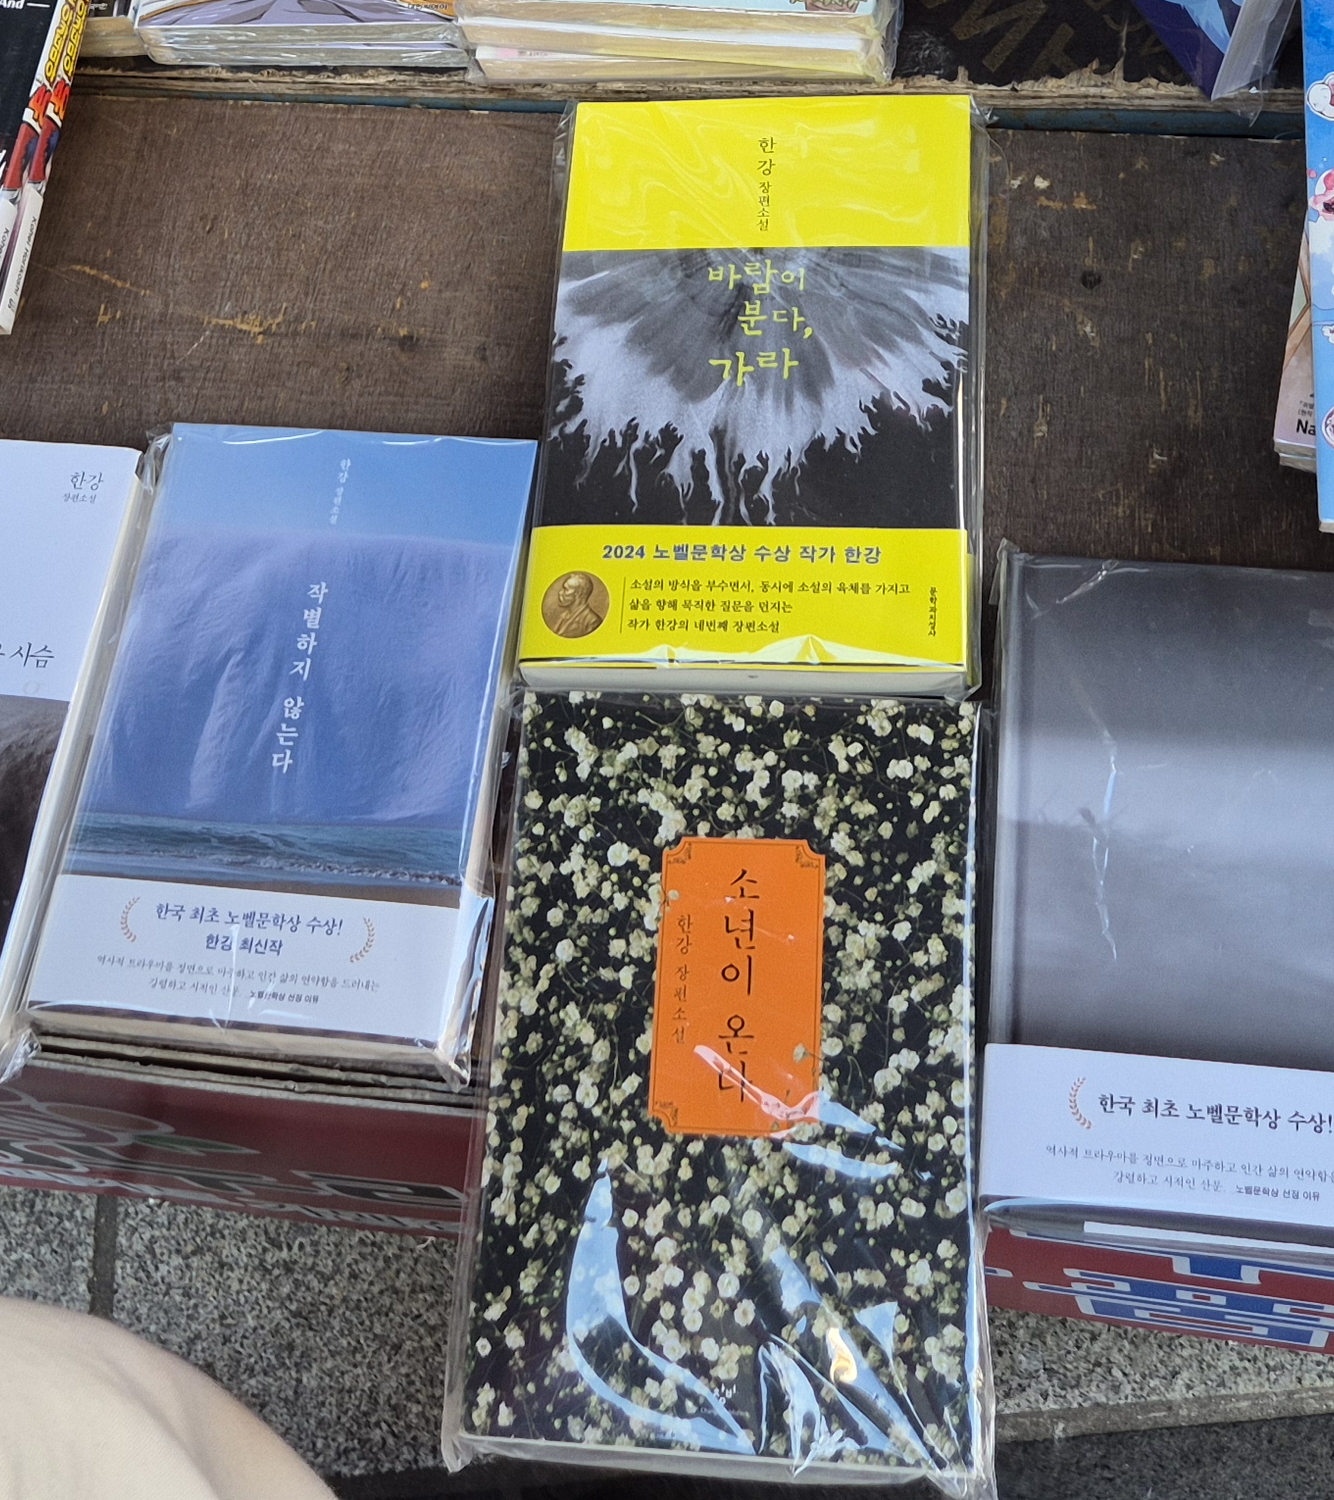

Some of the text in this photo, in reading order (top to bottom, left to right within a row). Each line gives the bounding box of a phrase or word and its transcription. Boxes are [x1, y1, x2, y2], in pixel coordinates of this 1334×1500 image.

[757, 136, 776, 175] 한강
[708, 258, 806, 295] 바람이
[739, 301, 812, 339] 분다,
[708, 346, 799, 386] 가라
[69, 470, 104, 491] 한강
[602, 544, 882, 564] 2024 노벨문학상 수상 작가 한강
[630, 578, 910, 595] 소설의 방식을 부수면서, 동시에 소설의 육체를 가지고
[629, 597, 792, 613] 삶을 향해 묵직한 질문을 던지는
[627, 618, 780, 633] 작가 한강의 네번째 장편소설
[11, 642, 56, 668] 사슴
[271, 580, 328, 774] 작별하지 않는다
[155, 901, 343, 937] 한국 최초 노벨문학상 수상!
[721, 866, 761, 999] 소년이
[238, 935, 283, 957] 최신작
[1098, 1092, 1334, 1132] 한국 최초 노벨문학상 수상!
